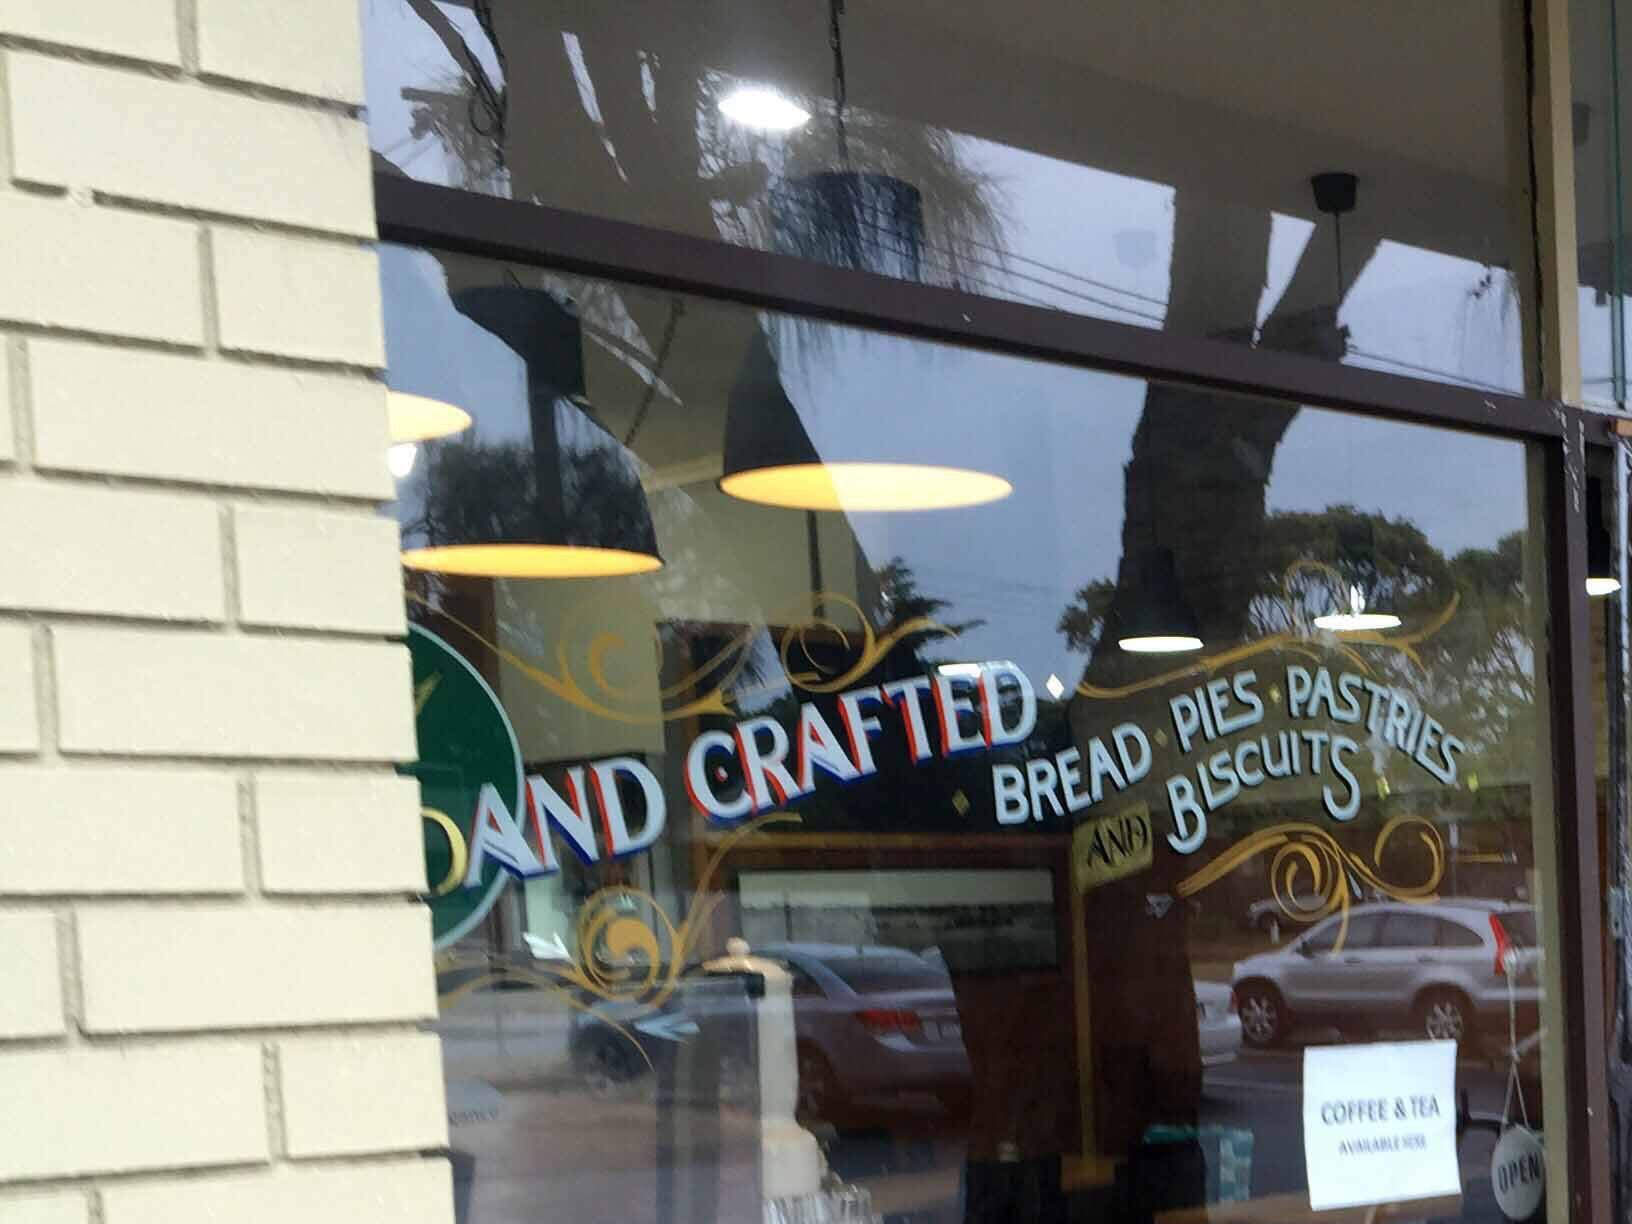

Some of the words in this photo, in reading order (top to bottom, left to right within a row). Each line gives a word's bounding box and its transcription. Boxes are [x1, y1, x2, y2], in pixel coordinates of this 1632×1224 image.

[685, 660, 1038, 826] CRAFTED
[992, 722, 1153, 826] BREAD
[1169, 670, 1264, 753] PIES
[1287, 665, 1467, 787] PASTRIES
[1087, 813, 1150, 872] AND
[1166, 729, 1362, 855] BISCUITS
[1321, 1098, 1388, 1126] COFFEE
[1394, 1096, 1407, 1120] &
[1410, 1093, 1440, 1119] TEA
[1498, 1151, 1541, 1194] OPEN
